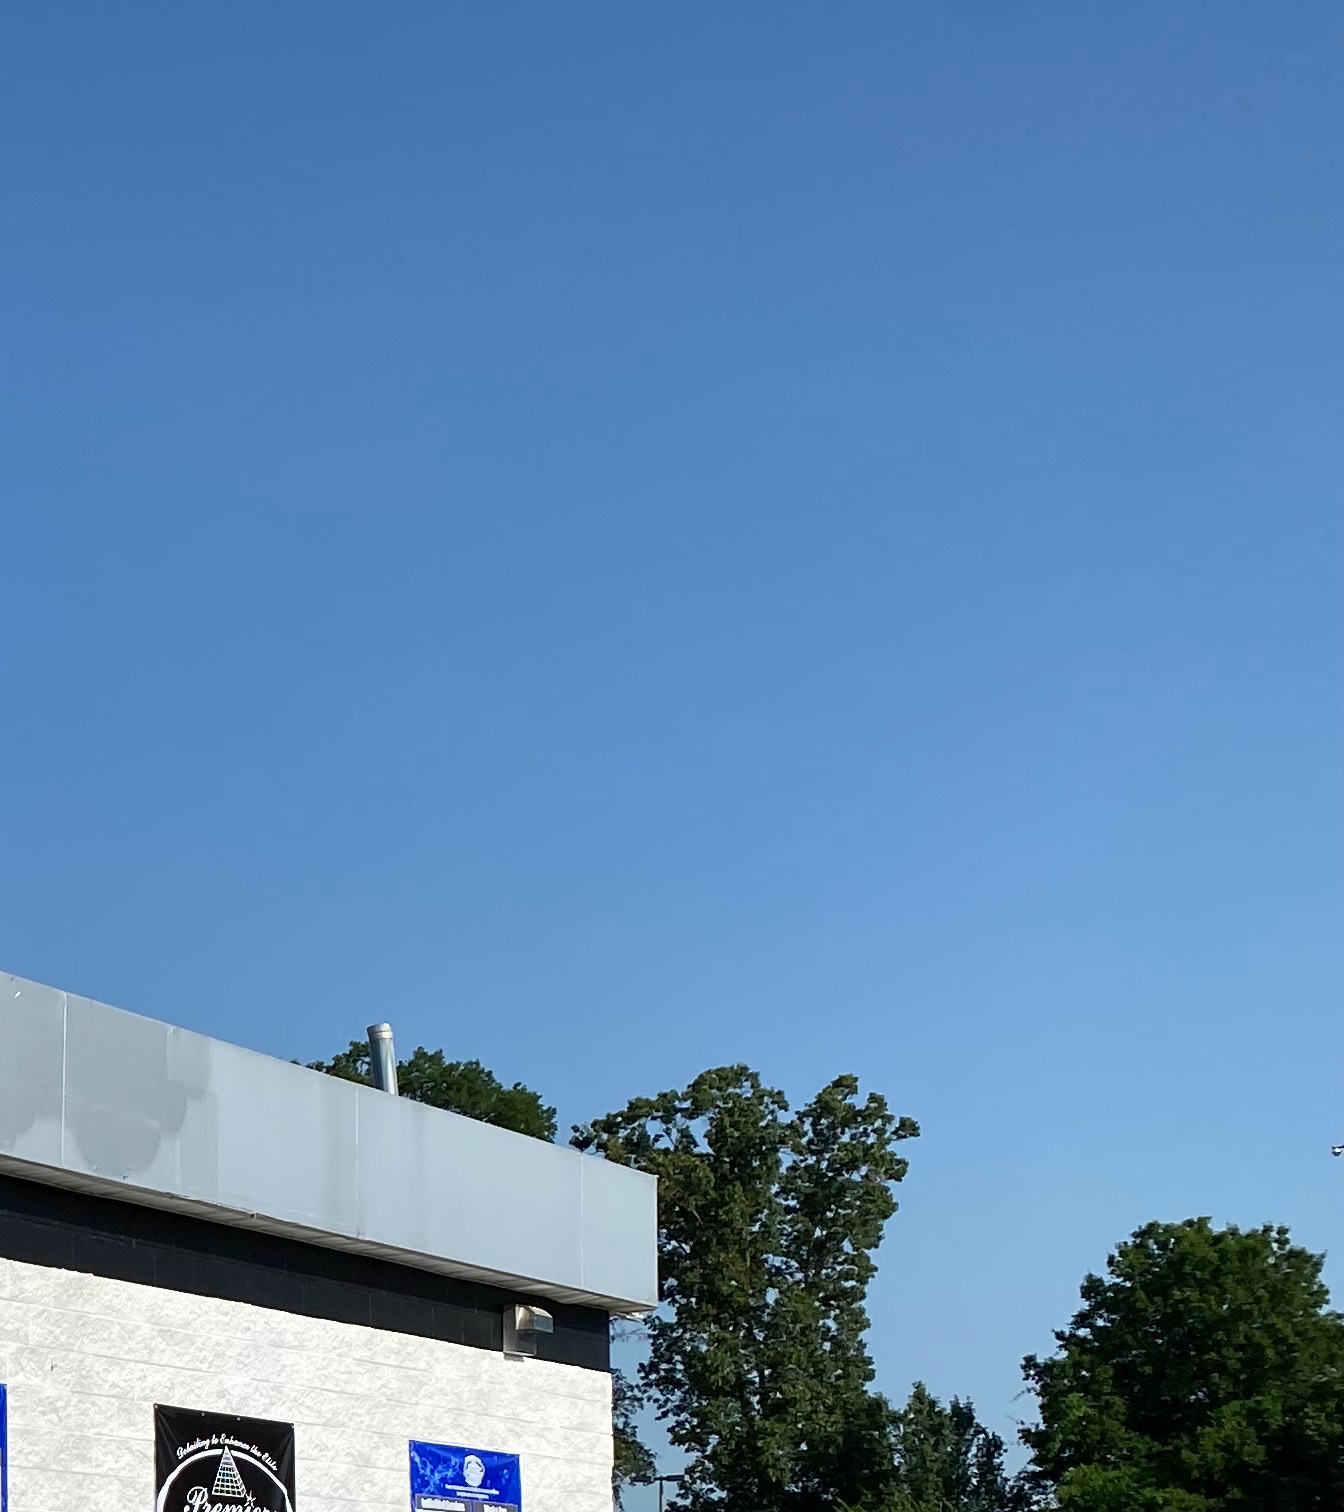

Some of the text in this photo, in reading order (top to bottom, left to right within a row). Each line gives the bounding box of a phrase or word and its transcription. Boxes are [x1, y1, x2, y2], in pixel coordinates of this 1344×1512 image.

[176, 1433, 278, 1471] Detailing to Enhance the Elite
